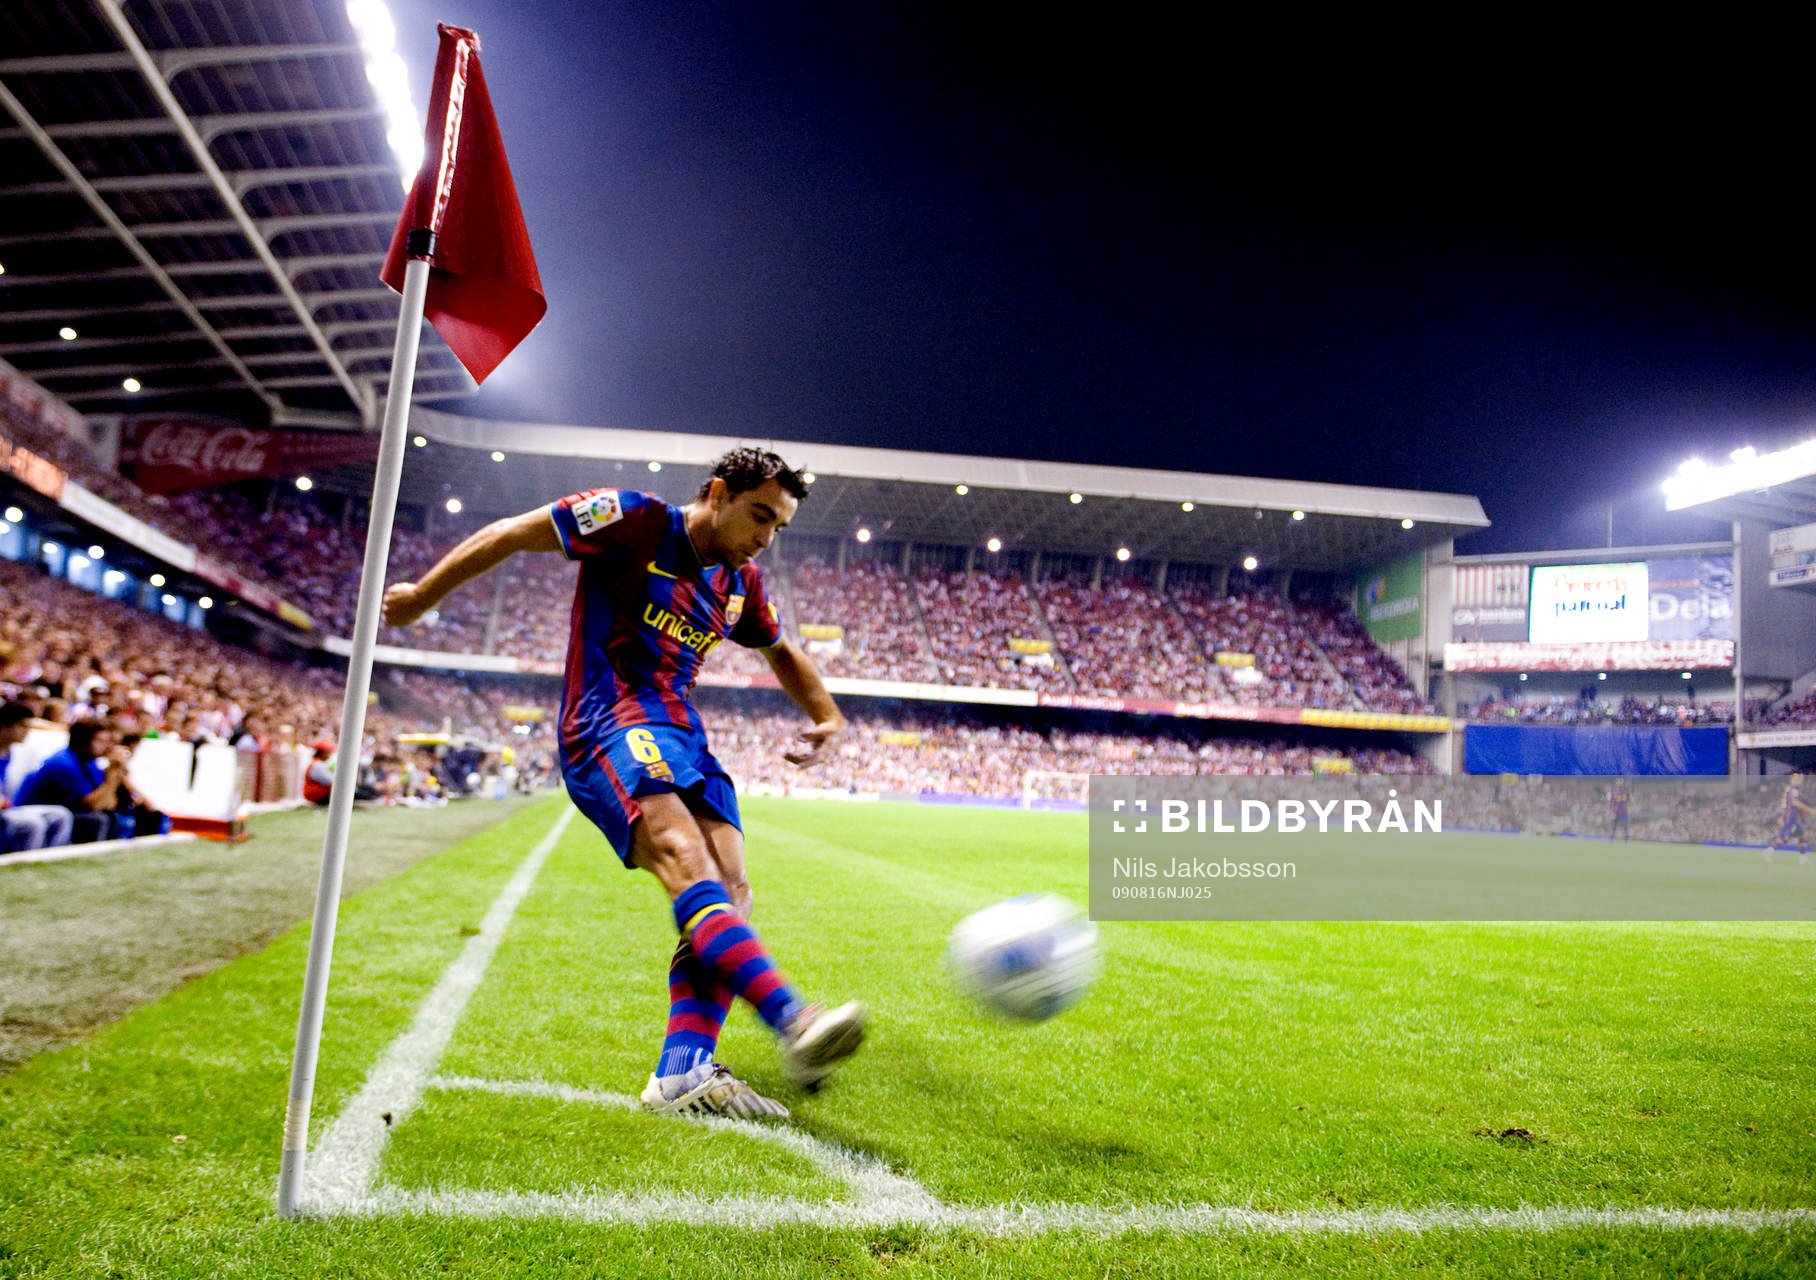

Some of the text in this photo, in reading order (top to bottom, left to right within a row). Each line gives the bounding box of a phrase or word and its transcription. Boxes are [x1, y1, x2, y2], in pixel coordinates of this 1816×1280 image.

[575, 504, 594, 529] LFP
[643, 603, 716, 653] unicef
[625, 728, 662, 764] 6
